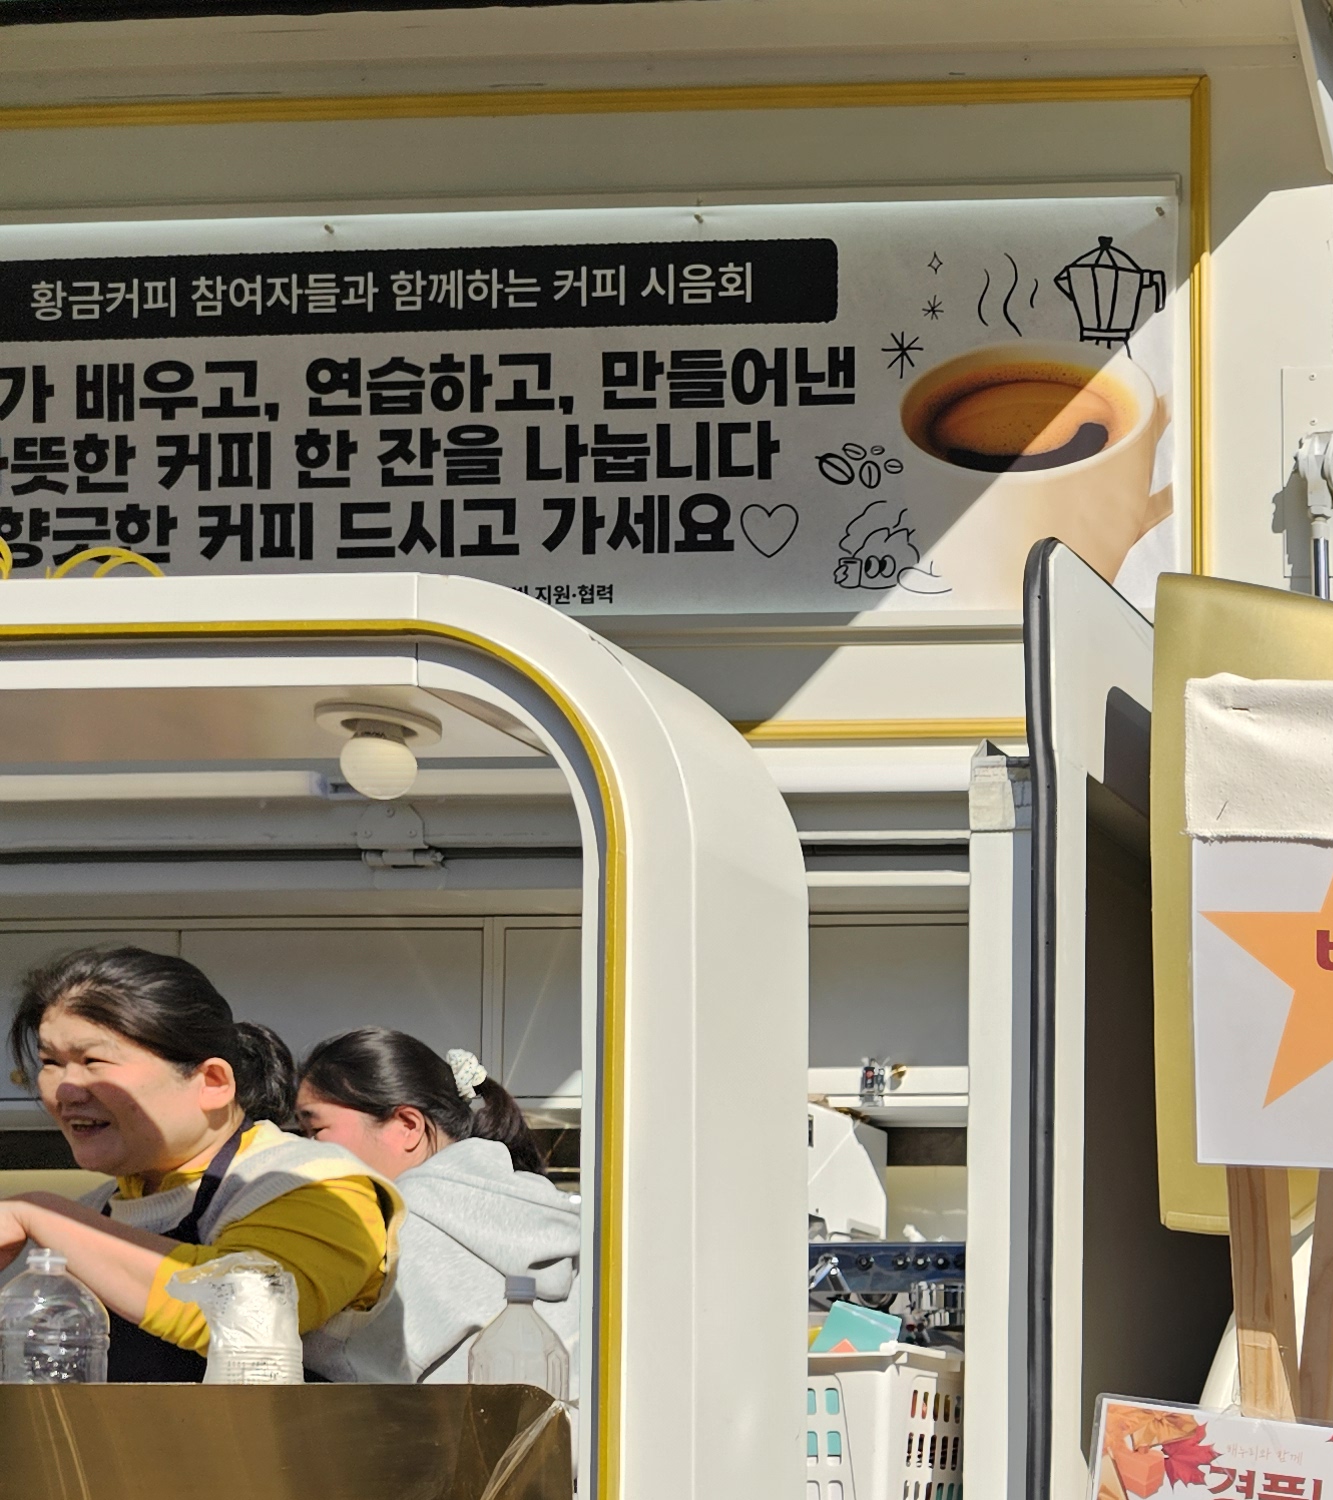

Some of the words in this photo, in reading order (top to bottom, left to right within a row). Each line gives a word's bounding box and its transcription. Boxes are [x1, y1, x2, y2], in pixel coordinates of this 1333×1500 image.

[31, 276, 177, 321] 황금커피
[191, 271, 379, 316] 참여자들과
[390, 268, 541, 312] 함께하는
[553, 265, 627, 307] 커피
[640, 261, 754, 305] 시음회
[0, 365, 55, 424] 가
[75, 359, 280, 423] 배우고,
[306, 353, 575, 418] 연습하고,
[601, 346, 856, 410] 만들어낸
[0, 432, 136, 496] 뜻한
[156, 431, 272, 491] 커피
[295, 427, 358, 489] 한
[377, 424, 503, 487] 잔을
[525, 420, 780, 483] 나눕니다
[198, 502, 314, 562] 커피
[337, 497, 520, 560] 드시고
[541, 493, 735, 555] 가세요
